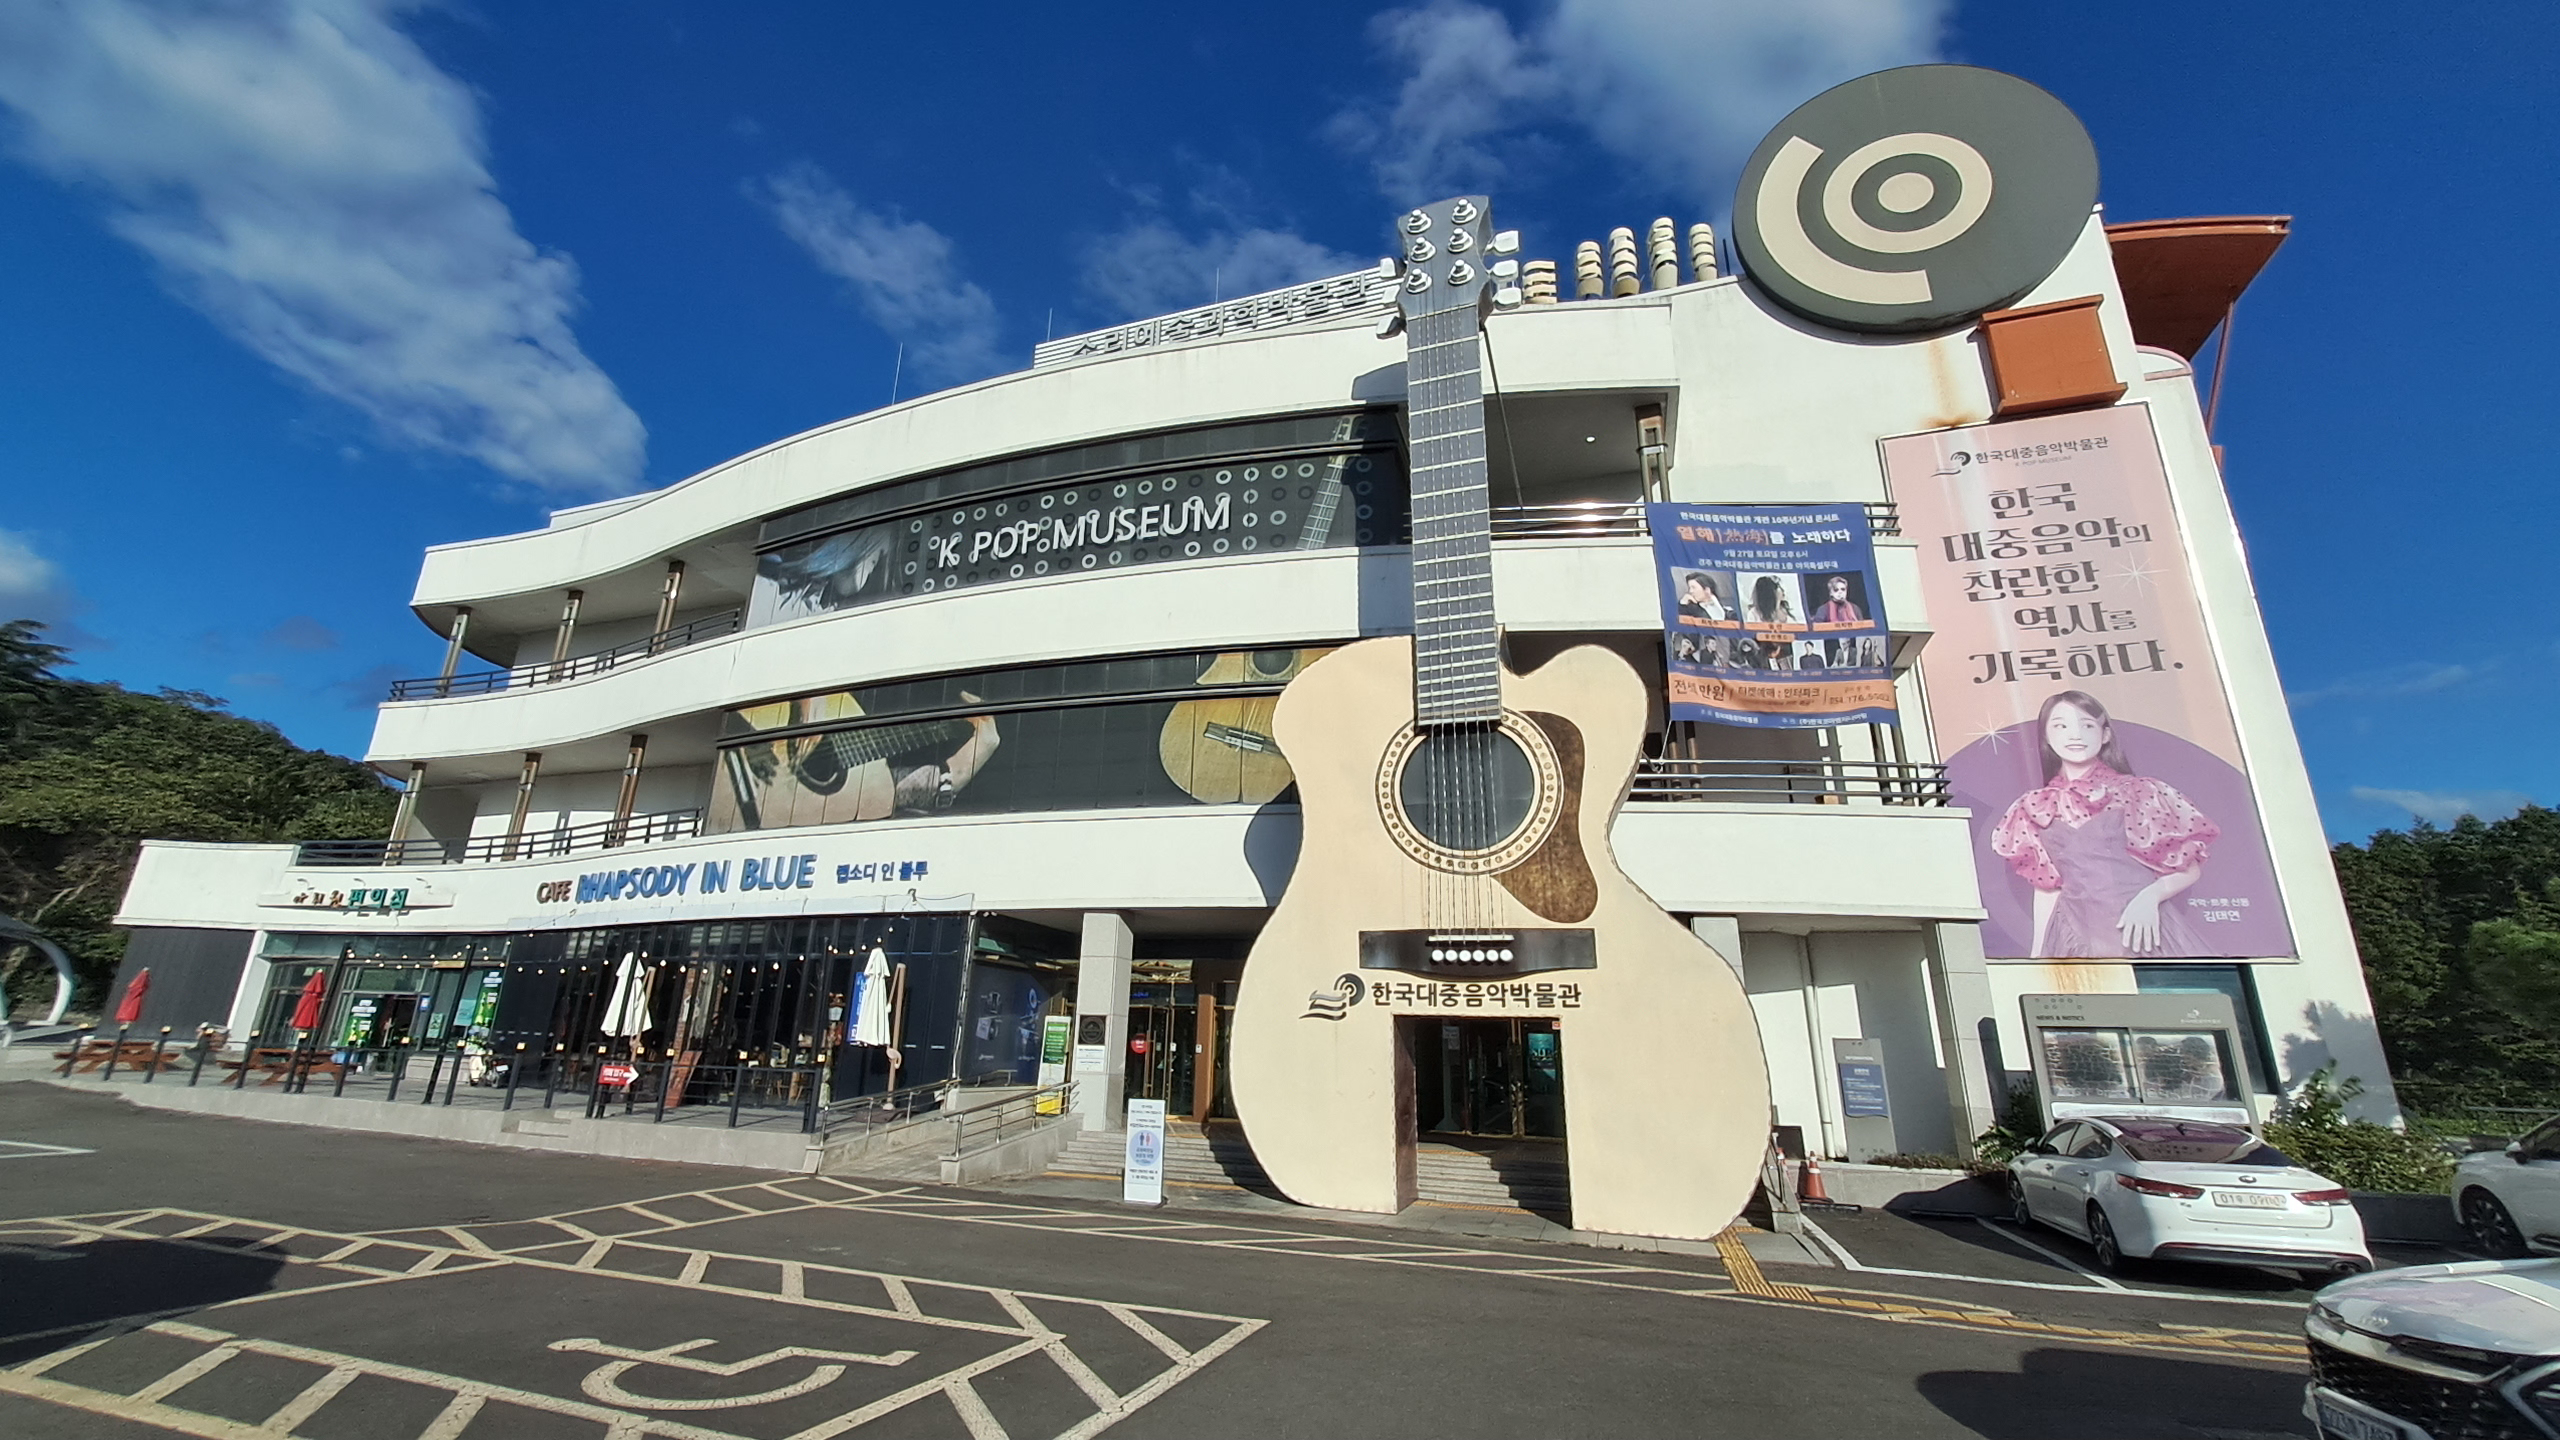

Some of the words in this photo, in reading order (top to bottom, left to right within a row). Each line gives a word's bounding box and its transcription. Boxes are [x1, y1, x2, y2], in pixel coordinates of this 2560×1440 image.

[1073, 274, 1371, 357] 소리예술과학박물관
[1976, 436, 2108, 464] 한국대중음악박물관
[1989, 482, 2077, 519] 한국
[938, 537, 960, 568] K
[973, 523, 1040, 562] POP
[1052, 497, 1231, 550] MUSEUM
[1791, 528, 1851, 544] 노래하다
[1941, 516, 2152, 563] 대중음악의
[1962, 560, 2100, 602] 찬란한
[2014, 601, 2137, 638] 역사를
[1968, 639, 2184, 684] 기록하다.
[536, 880, 573, 904] CAFE
[575, 863, 697, 904] RHAPSODY
[700, 860, 732, 895] IN
[740, 854, 817, 891] BLUE
[836, 862, 877, 884] 랩소디
[881, 861, 895, 882] 인
[898, 861, 929, 882] 블루
[348, 888, 409, 909] 편의점
[2203, 910, 2241, 922] 김태연
[1371, 982, 1582, 1008] 한국대중음악박물관
